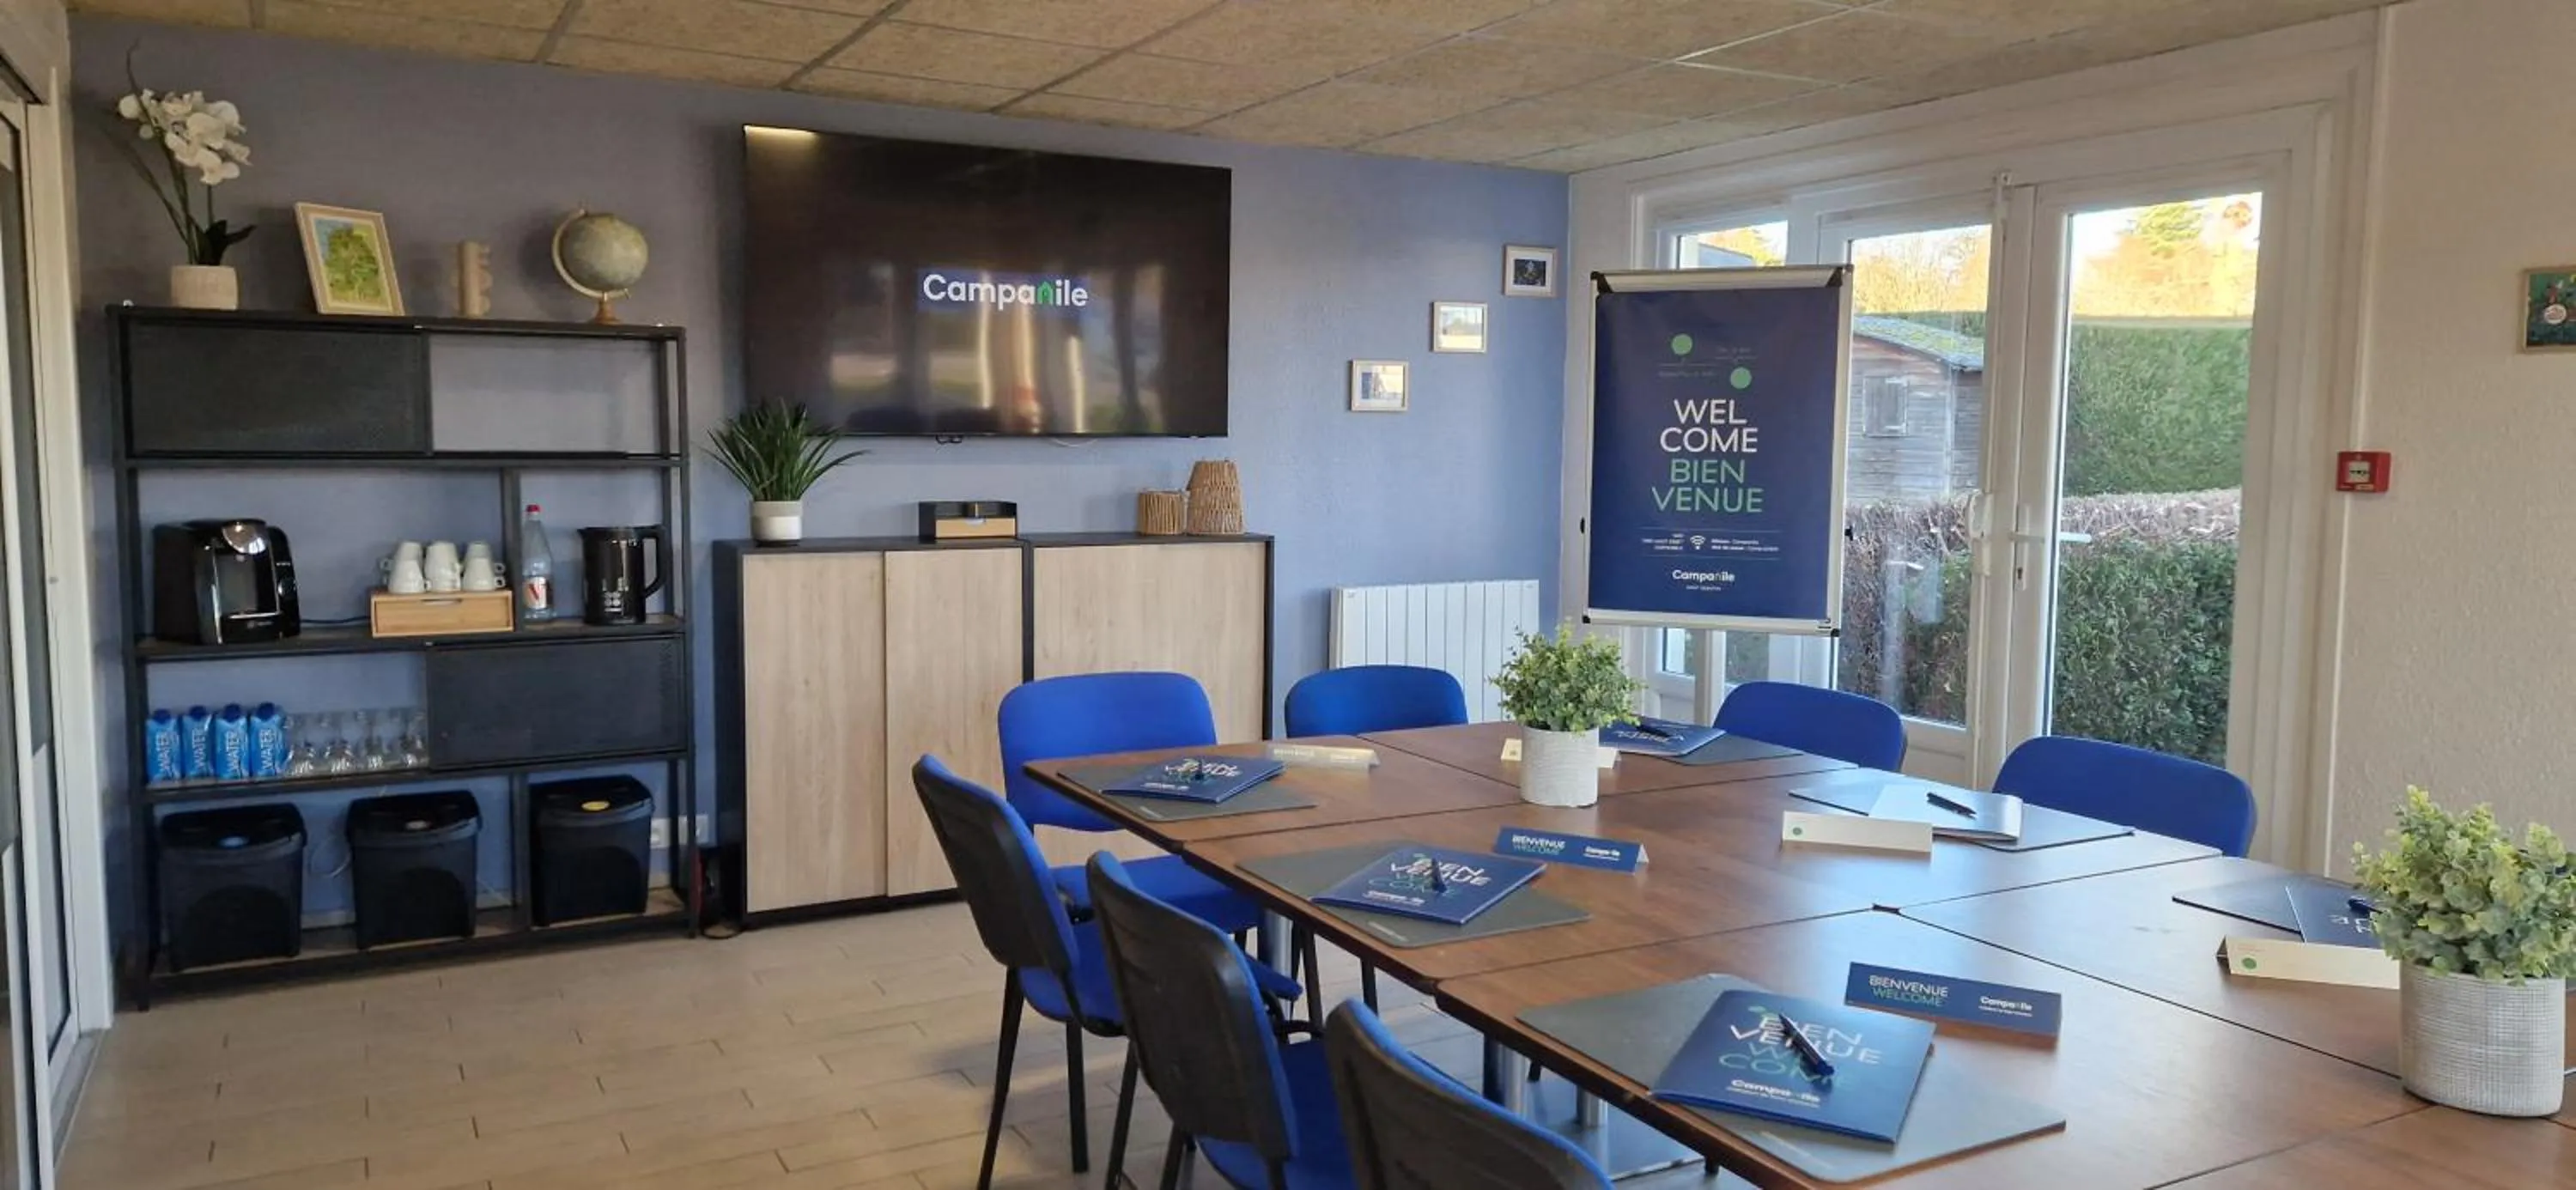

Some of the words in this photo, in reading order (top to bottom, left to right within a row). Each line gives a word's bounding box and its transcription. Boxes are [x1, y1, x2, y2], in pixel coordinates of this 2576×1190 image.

[923, 274, 1089, 311] Campanile
[1674, 398, 1747, 424] WEL
[1660, 427, 1759, 453] COME
[1670, 459, 1745, 485] BIEN
[1651, 486, 1764, 513] VENUE
[1672, 569, 1735, 583] Campanile
[155, 732, 171, 773] WATER
[191, 728, 206, 768] WATER
[226, 731, 240, 772] WATER
[260, 729, 275, 770] WATER
[1868, 974, 1949, 998] BIENVENUE
[1873, 987, 1943, 1008] WELCOME
[1980, 996, 2033, 1011] Campaile
[1759, 1015, 1862, 1046] BEN
[1730, 1079, 1821, 1103] Campaile
